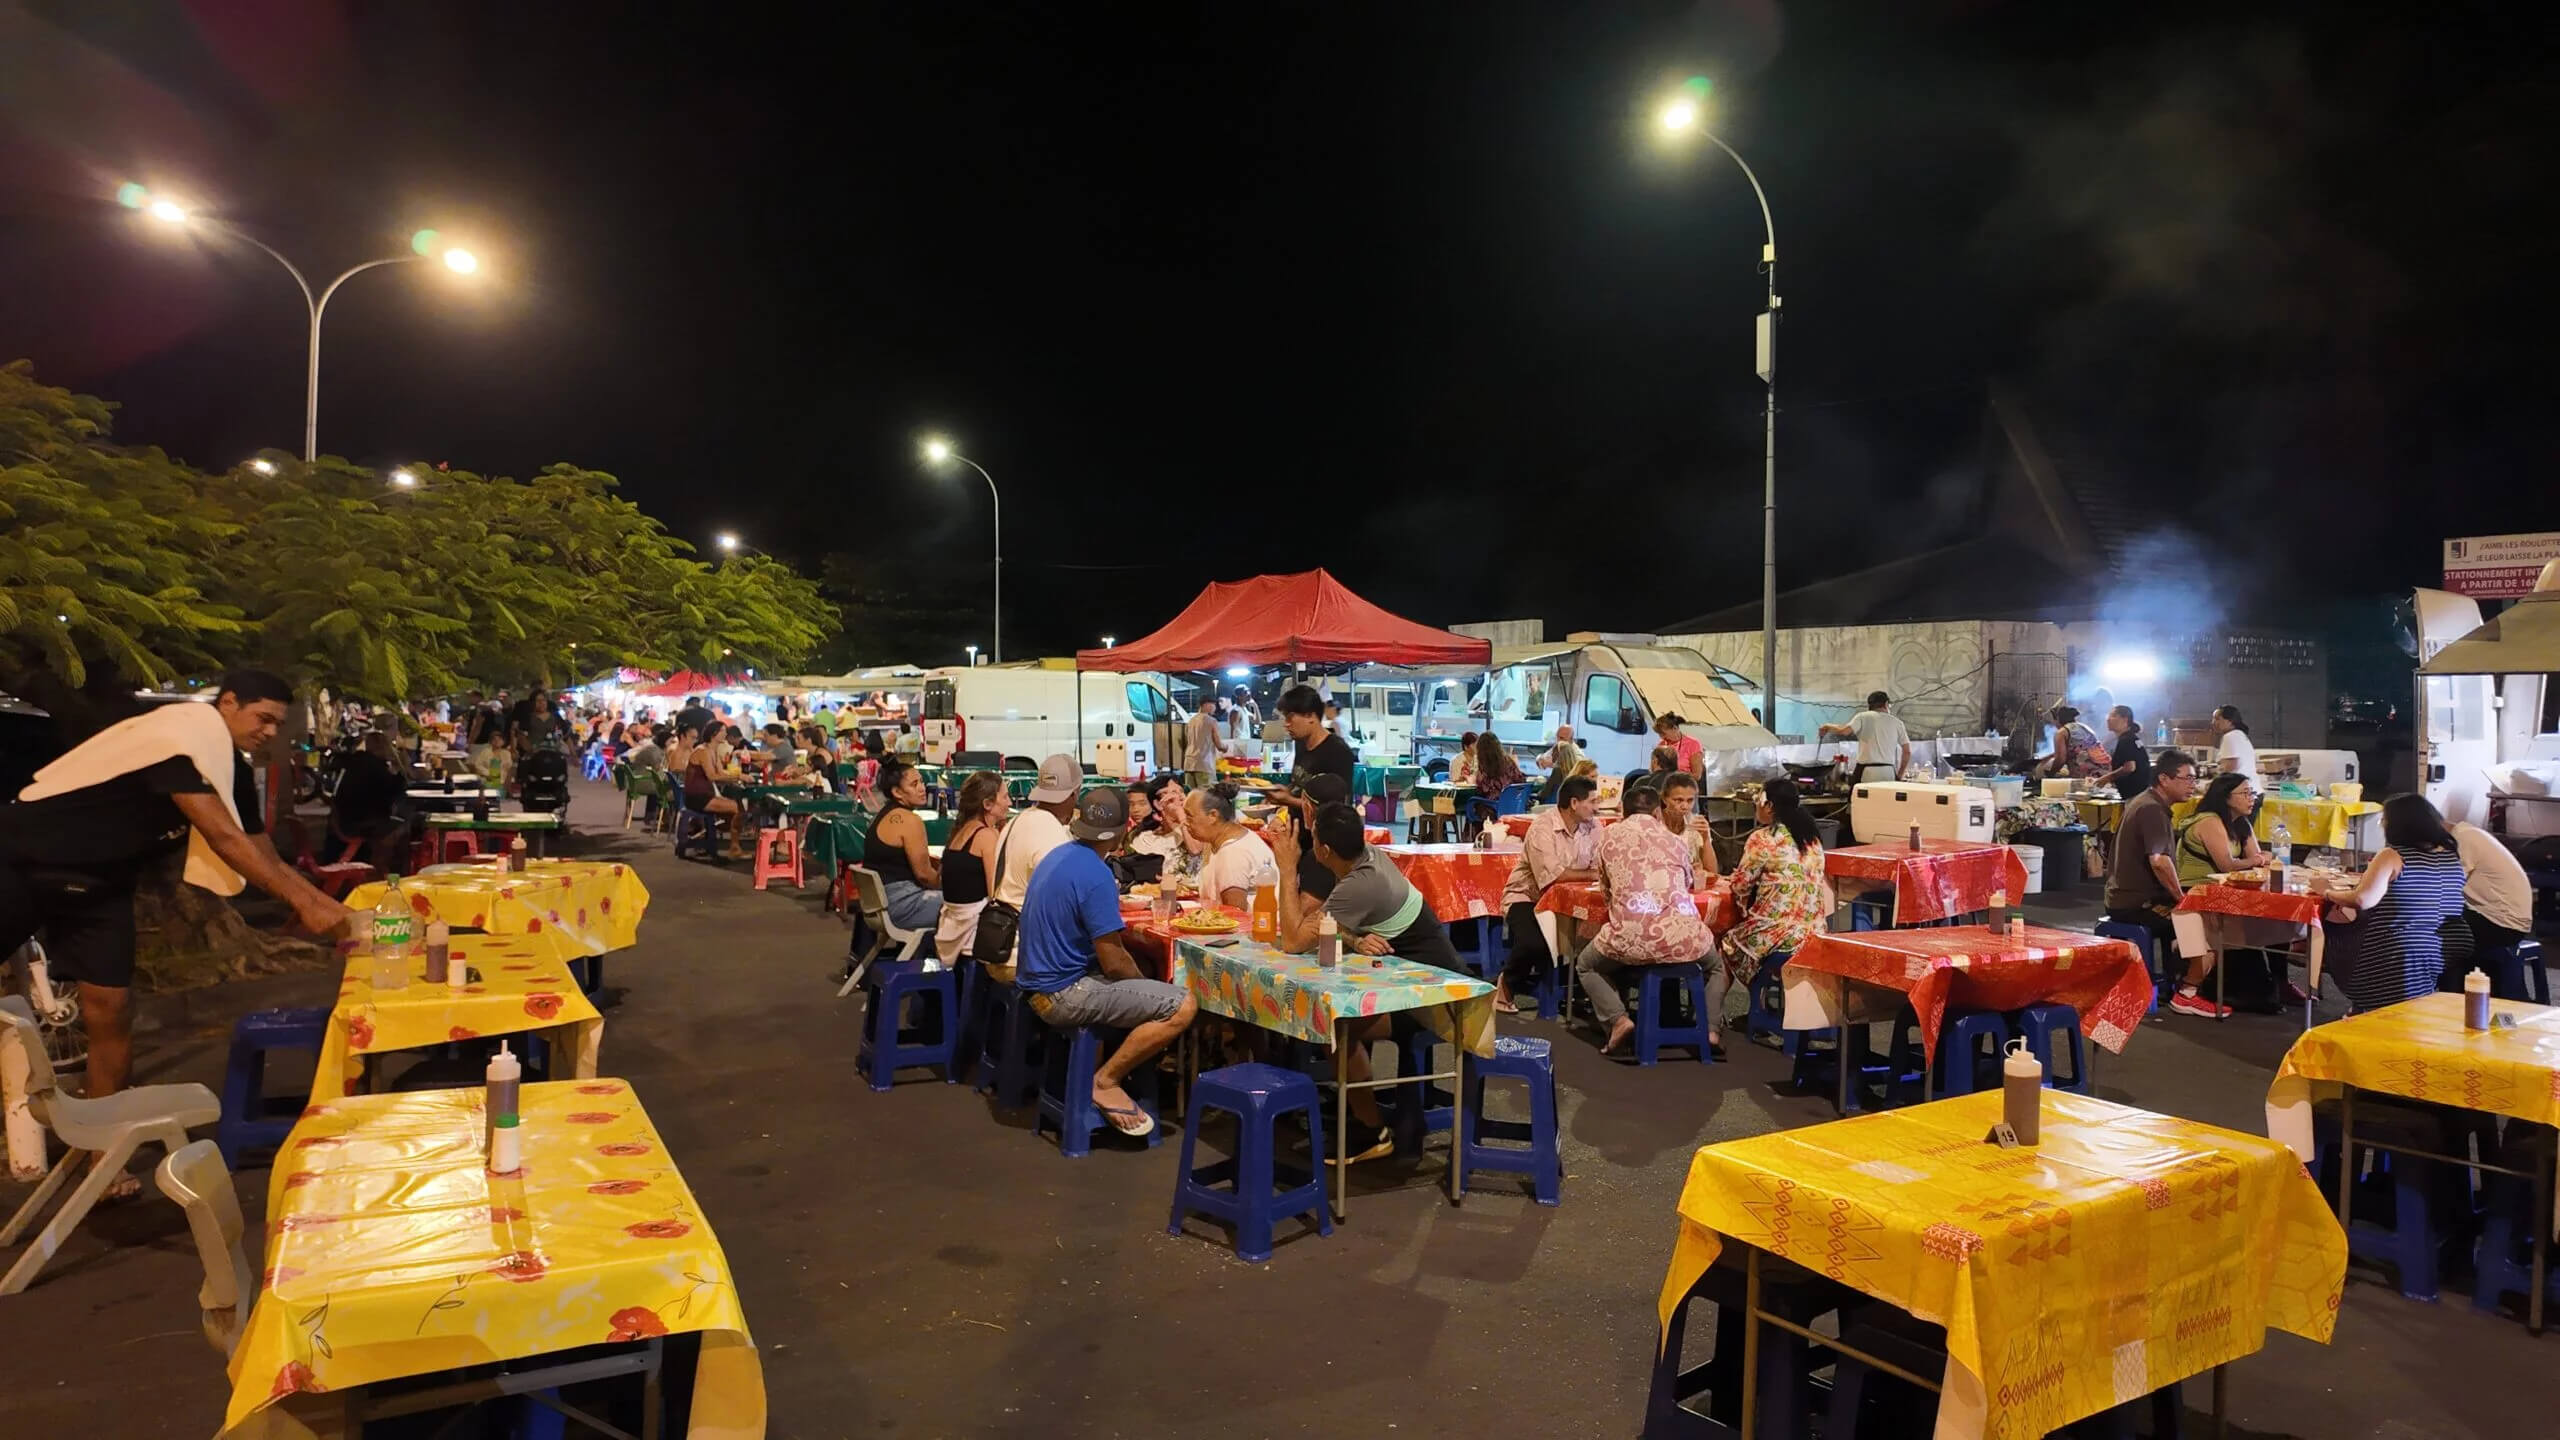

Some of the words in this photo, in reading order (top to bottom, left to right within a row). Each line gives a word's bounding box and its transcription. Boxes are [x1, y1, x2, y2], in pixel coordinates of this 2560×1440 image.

[2506, 553, 2530, 561] LAISSE
[2444, 568, 2522, 580] STATIONNEMENT
[2461, 580, 2467, 589] A
[2469, 580, 2503, 589] PARTIR
[2505, 579, 2518, 588] DE
[2001, 1130, 2015, 1143] 19
